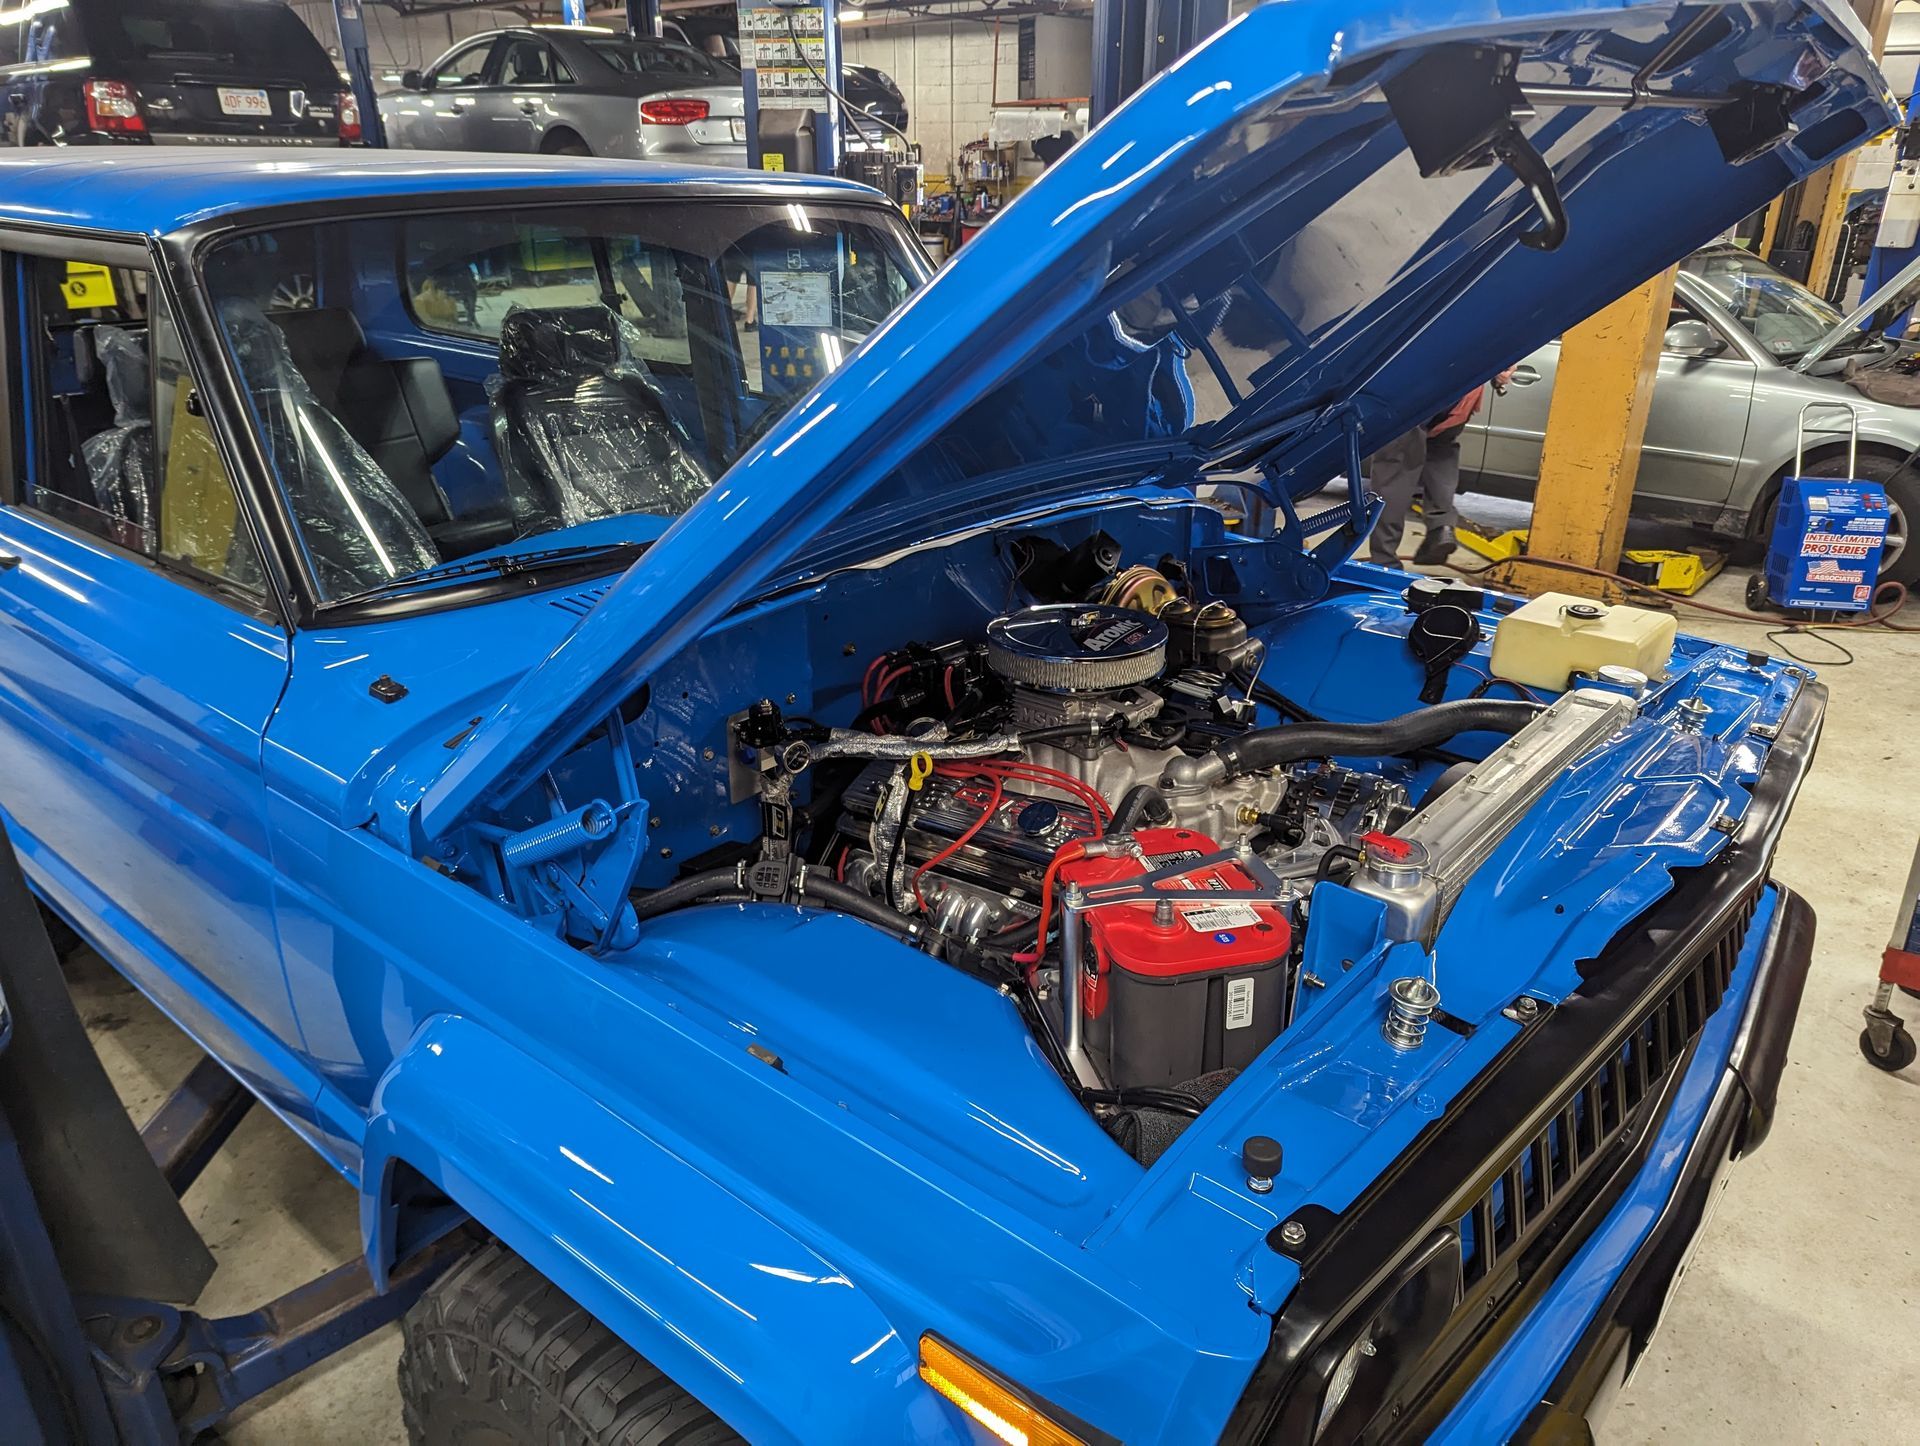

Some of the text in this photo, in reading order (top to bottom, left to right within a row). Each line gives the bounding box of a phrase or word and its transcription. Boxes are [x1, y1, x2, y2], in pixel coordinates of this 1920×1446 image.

[224, 95, 267, 109] 4DF 996
[1805, 533, 1882, 545] INTELLAMATIC
[1802, 543, 1868, 555] PRO SERIES
[1815, 574, 1862, 583] ASSOCIATED
